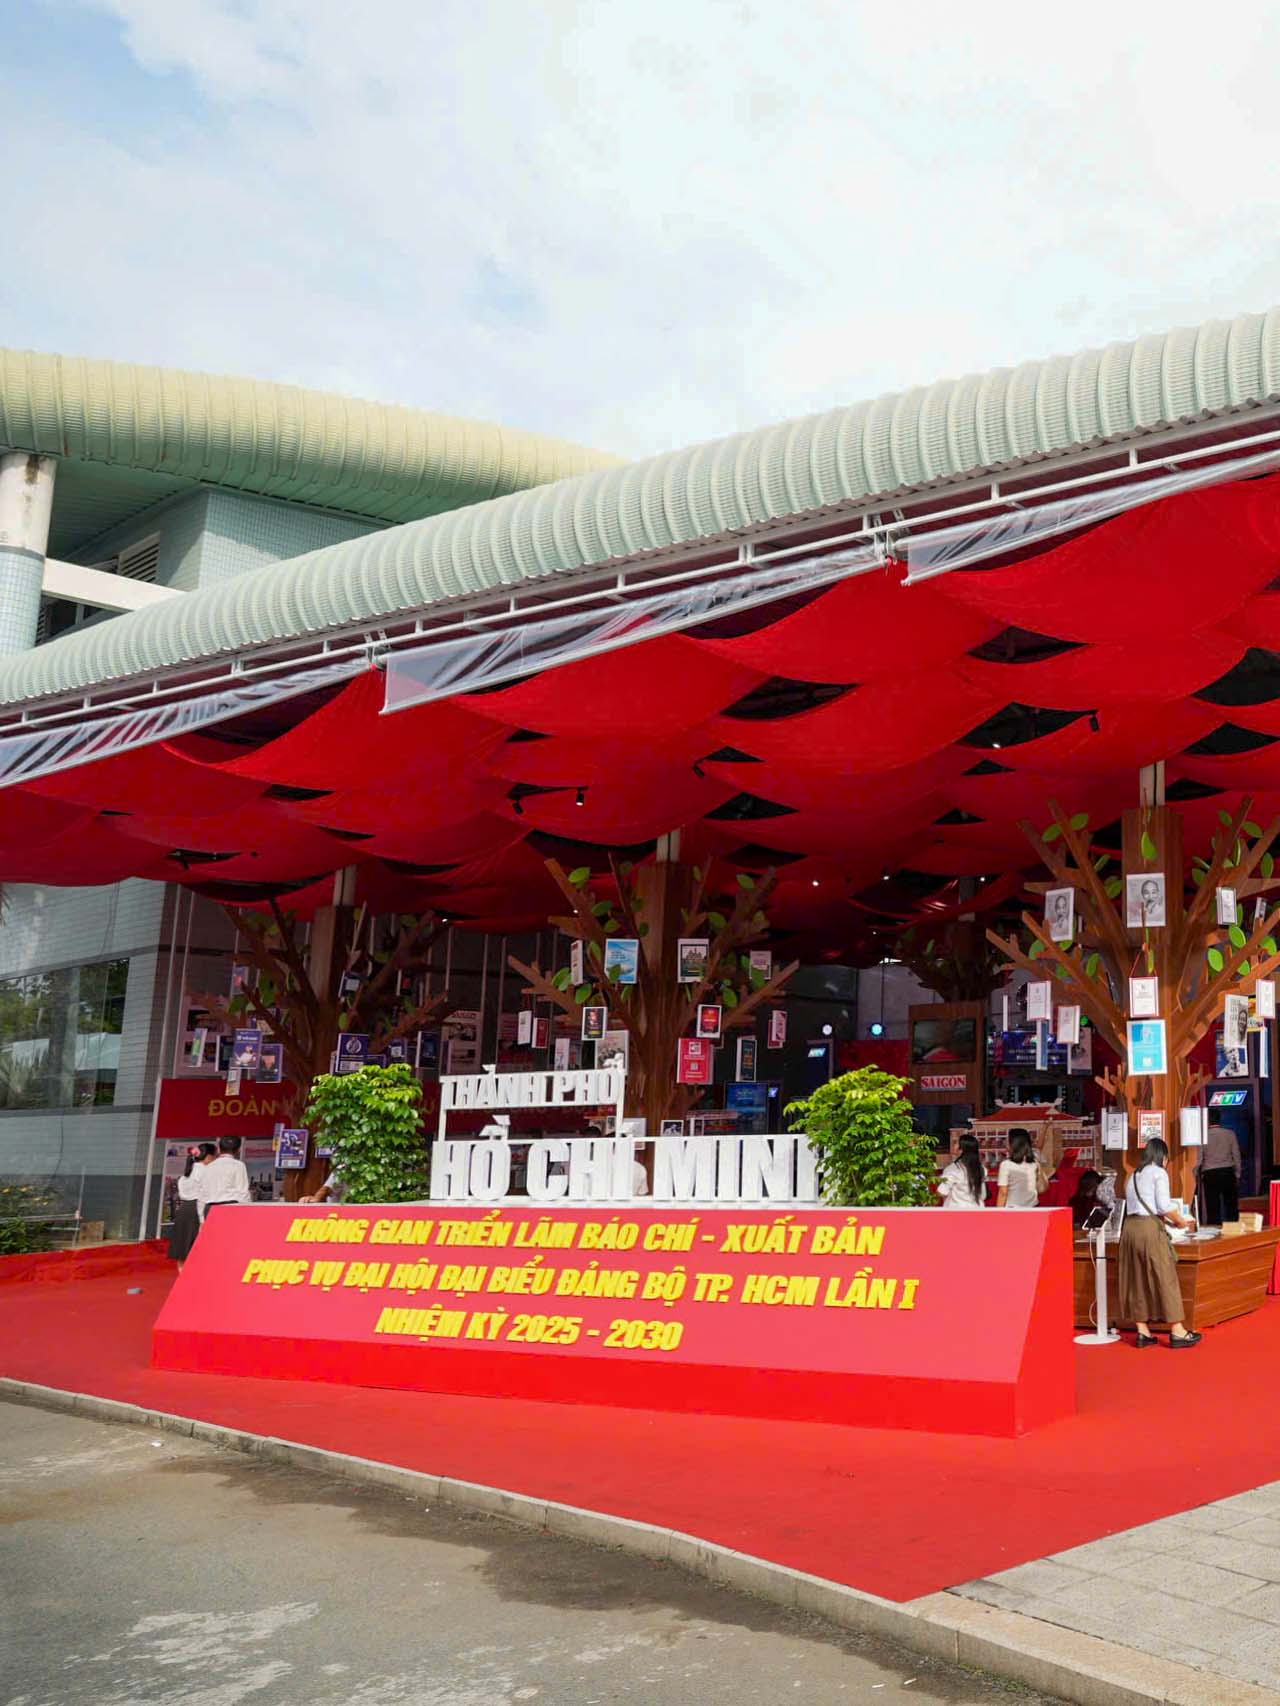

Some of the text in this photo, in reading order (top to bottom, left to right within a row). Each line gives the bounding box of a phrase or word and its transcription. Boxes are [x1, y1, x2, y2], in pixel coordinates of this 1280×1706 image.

[439, 1052, 625, 1107] THÀNH PHỐ
[1211, 1091, 1246, 1106] HTV
[208, 1096, 276, 1116] ĐOÀN
[431, 1115, 511, 1201] HỒ
[527, 1120, 634, 1201] CHÍ
[286, 1208, 885, 1256] KHÔNG GIAN TRIỂN LÃM BÁO CHÍ - XUẤT BẢN
[242, 1254, 919, 1310] PHỤC VỤ ĐẠI HỘI ĐẠI BIỂU ĐẢNG BỘ TP. HCM LẦN I
[375, 1304, 684, 1352] NHIỆM KỲ 2025 - 2030
